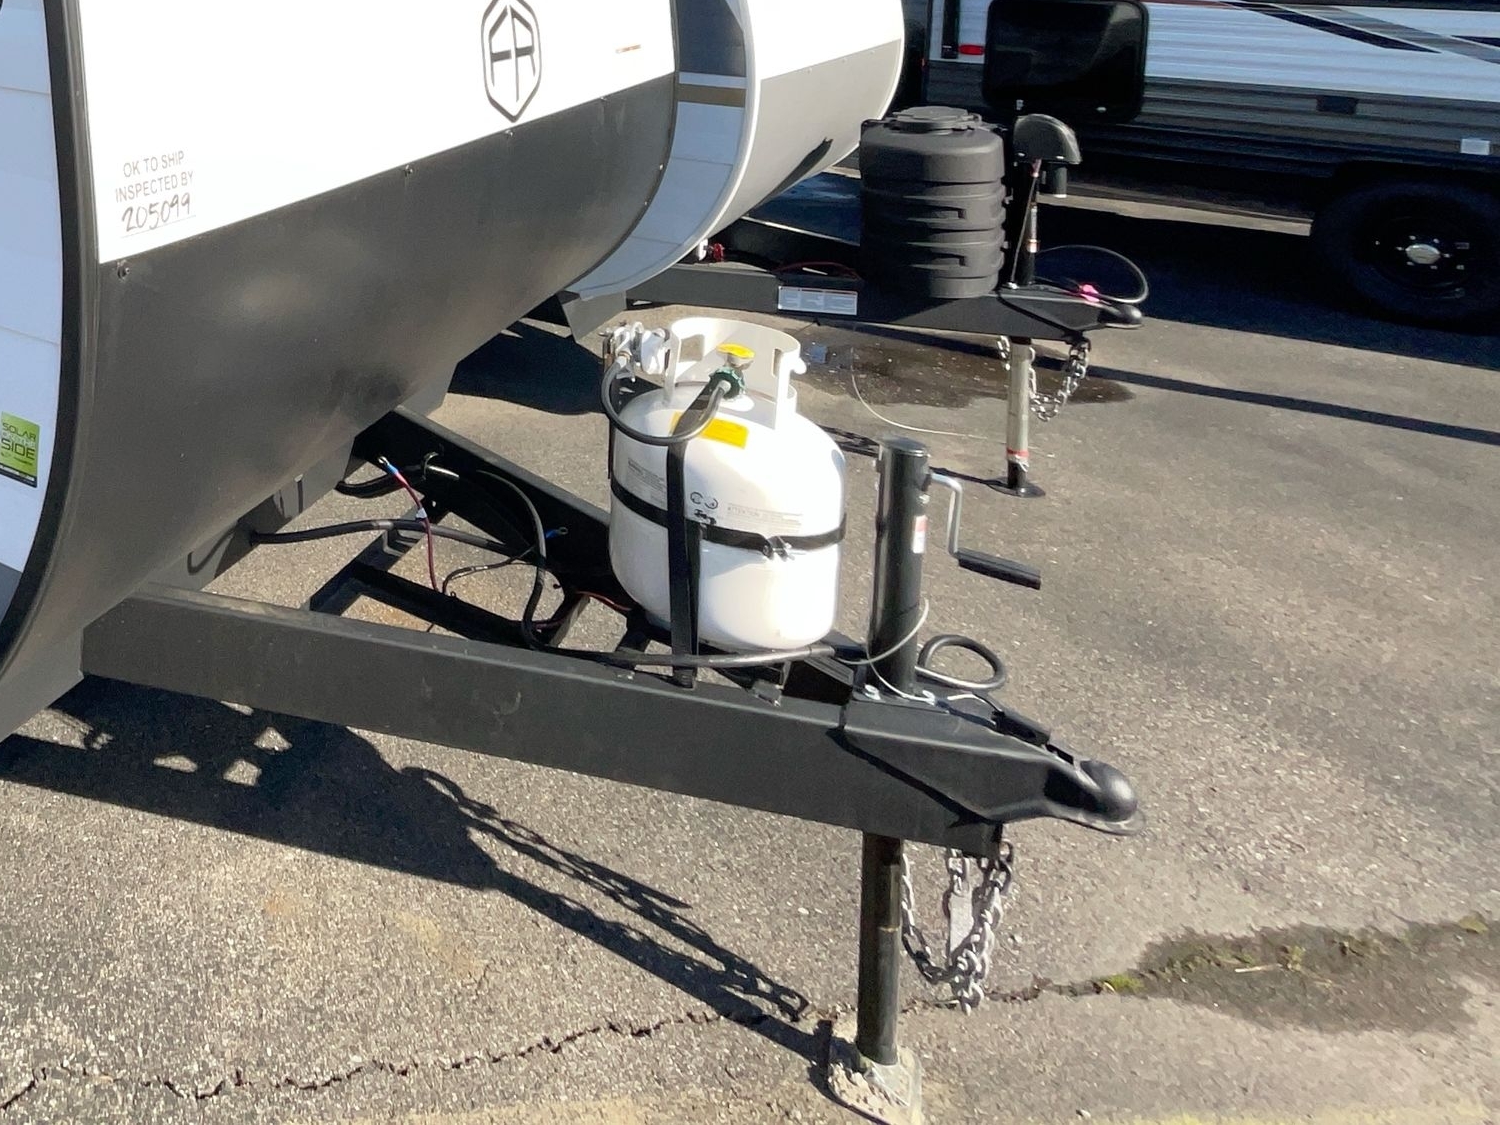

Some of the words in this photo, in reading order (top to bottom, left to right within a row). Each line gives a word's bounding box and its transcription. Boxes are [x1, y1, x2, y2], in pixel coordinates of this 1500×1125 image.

[122, 160, 141, 178] OK
[144, 156, 159, 173] TO
[161, 150, 185, 170] SHIP
[115, 175, 178, 203] INSPECTED
[180, 170, 194, 187] BY
[2, 422, 37, 442] SOLAR
[1, 438, 36, 461] SIDE
